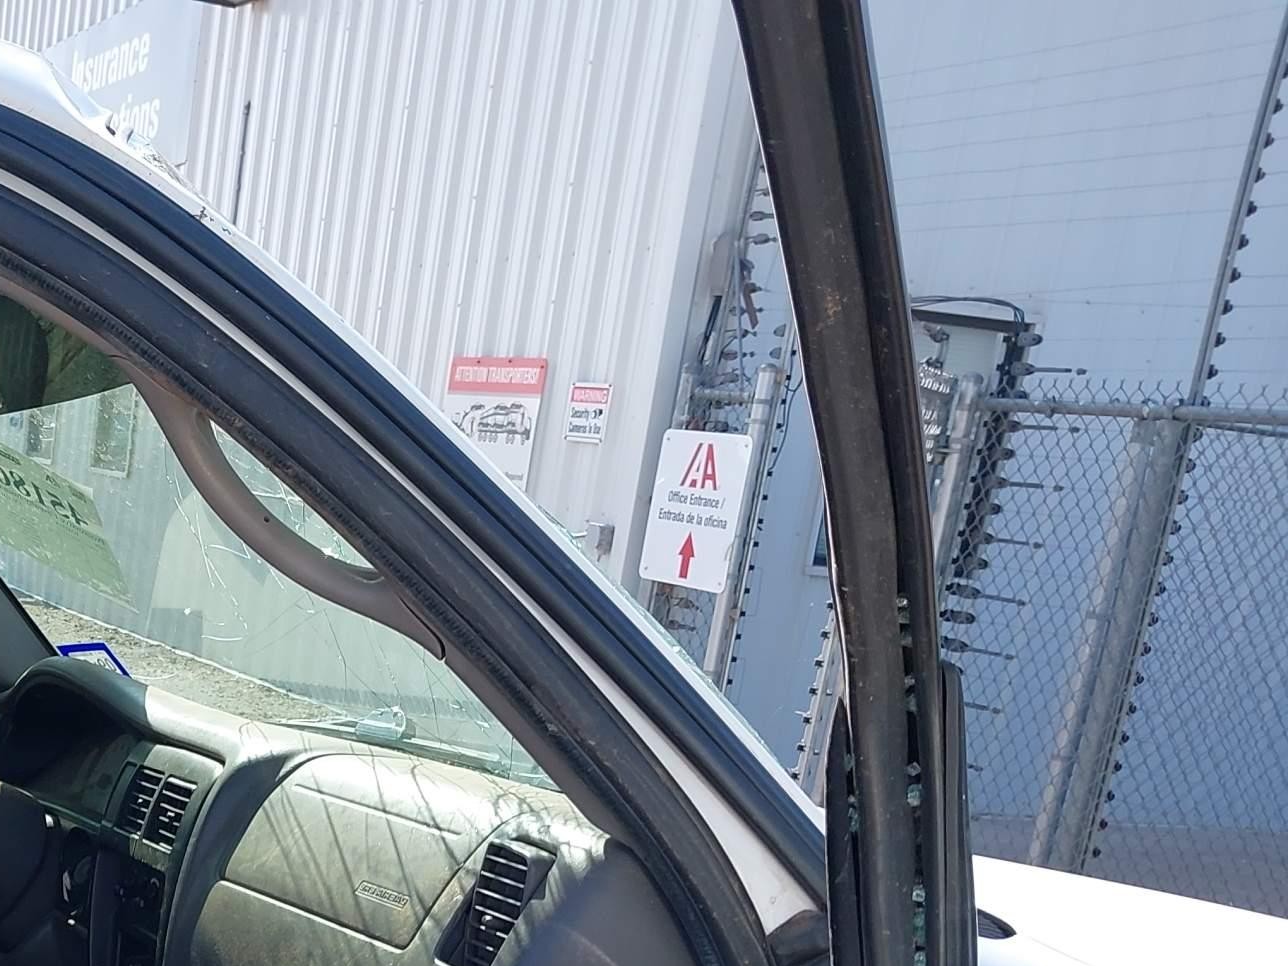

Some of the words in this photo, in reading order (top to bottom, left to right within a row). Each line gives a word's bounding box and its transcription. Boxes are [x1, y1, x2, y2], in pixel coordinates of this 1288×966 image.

[72, 33, 150, 92] Insurance
[668, 490, 688, 505] Office
[689, 493, 720, 509] Entrance
[658, 508, 685, 523] Entrada
[686, 512, 695, 524] de
[696, 513, 702, 525] la
[703, 514, 728, 529] oficina
